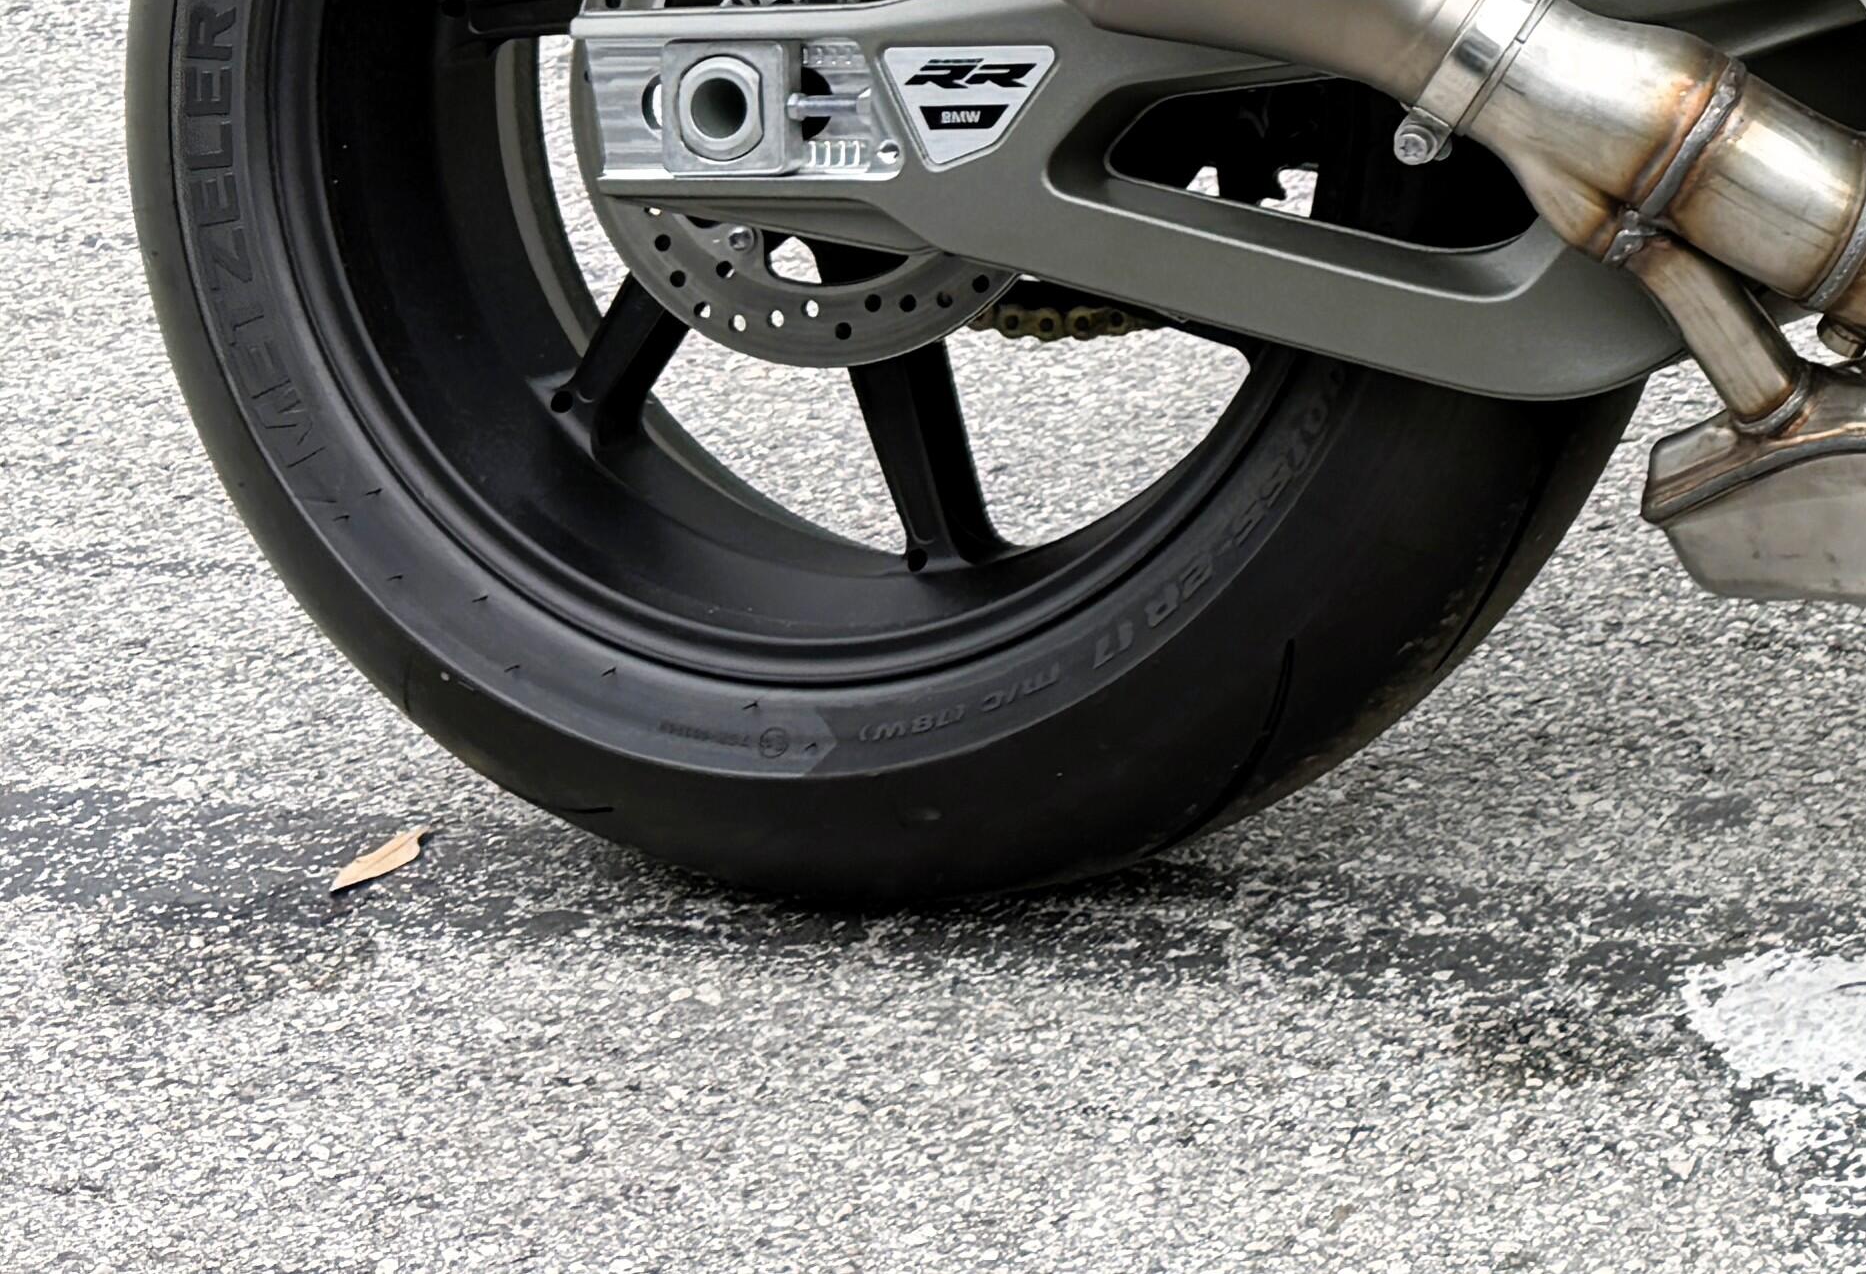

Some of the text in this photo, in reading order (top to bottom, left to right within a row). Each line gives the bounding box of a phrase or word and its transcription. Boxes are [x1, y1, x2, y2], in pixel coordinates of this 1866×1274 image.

[904, 63, 1039, 90] RR
[940, 110, 982, 125] BMW
[183, 2, 329, 469] METZELER
